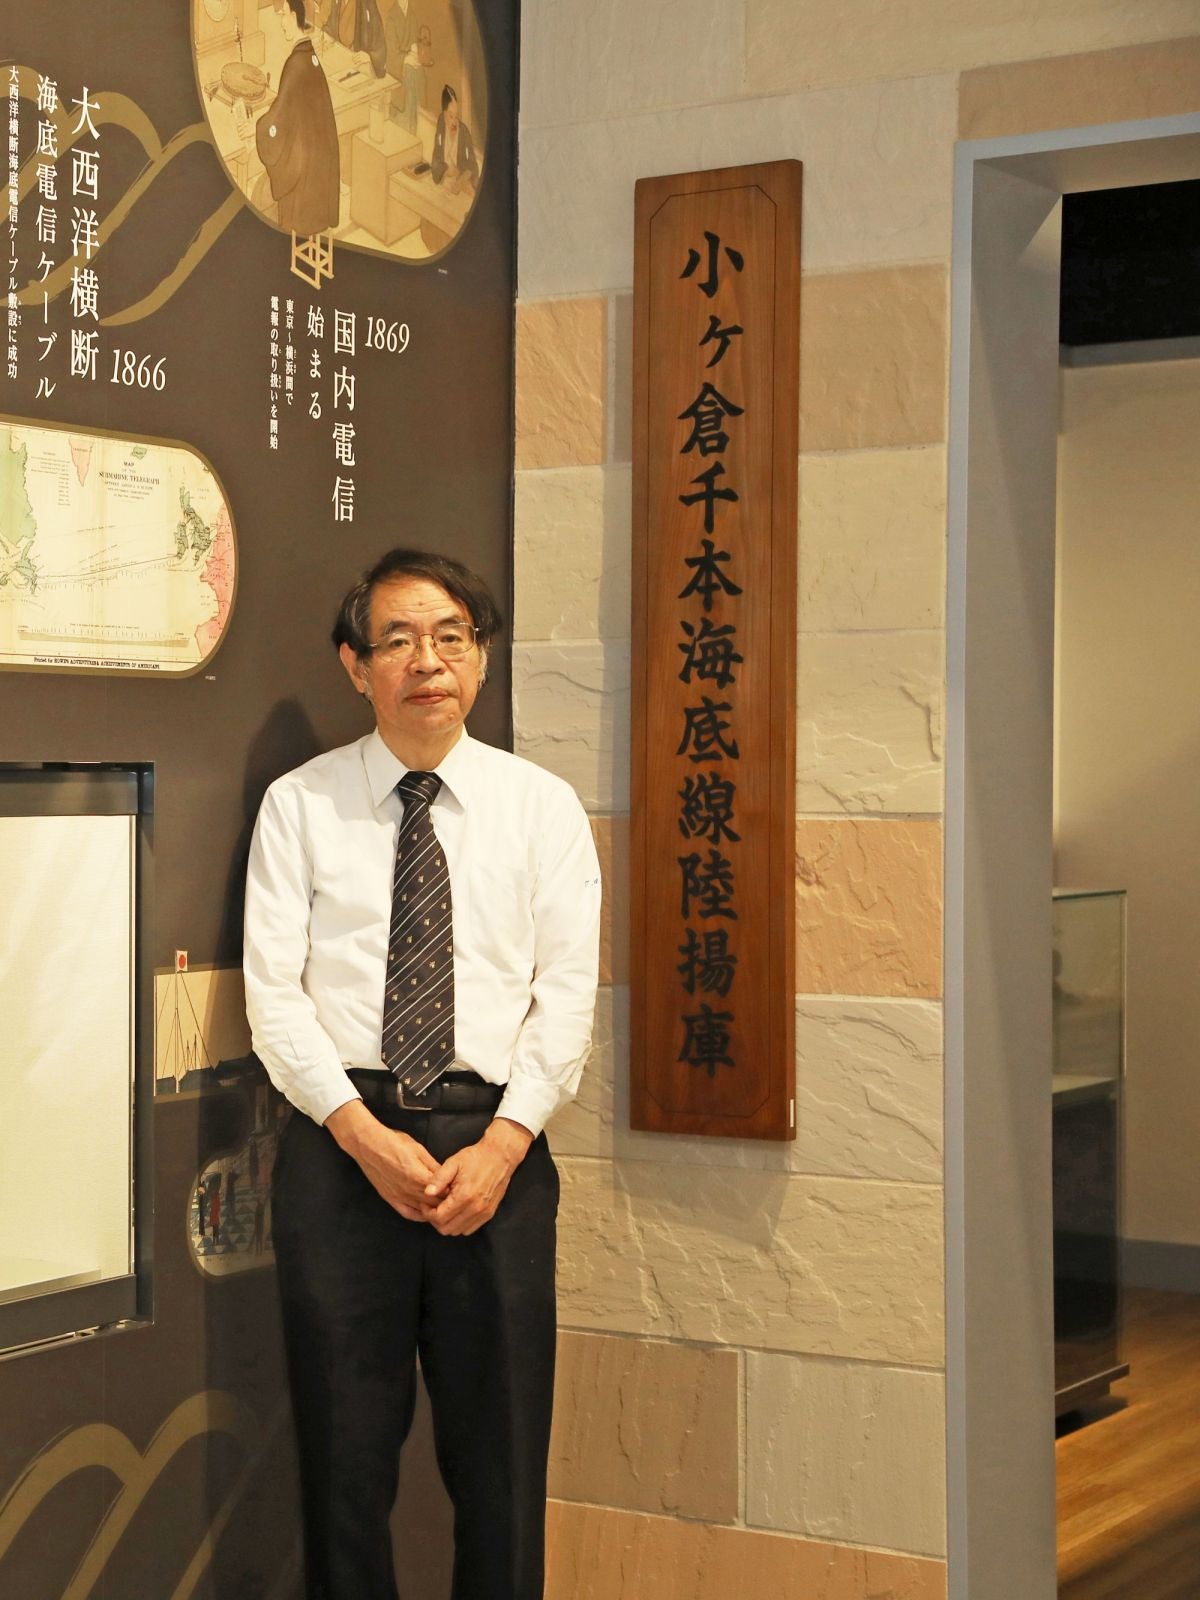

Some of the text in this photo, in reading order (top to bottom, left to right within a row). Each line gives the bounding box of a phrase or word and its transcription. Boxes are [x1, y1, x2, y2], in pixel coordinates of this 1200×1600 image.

[7, 65, 18, 379] 大西洋横断海底電信ケーブル敷設に成功
[35, 74, 59, 399] 海底電信ケーブル
[69, 86, 101, 381] 大西洋横断
[110, 349, 166, 391] 1866
[269, 295, 279, 450] 電報の取り扱いを開始
[307, 305, 325, 419] 始まる
[331, 309, 356, 522] 国内電信
[365, 316, 410, 354] 1869
